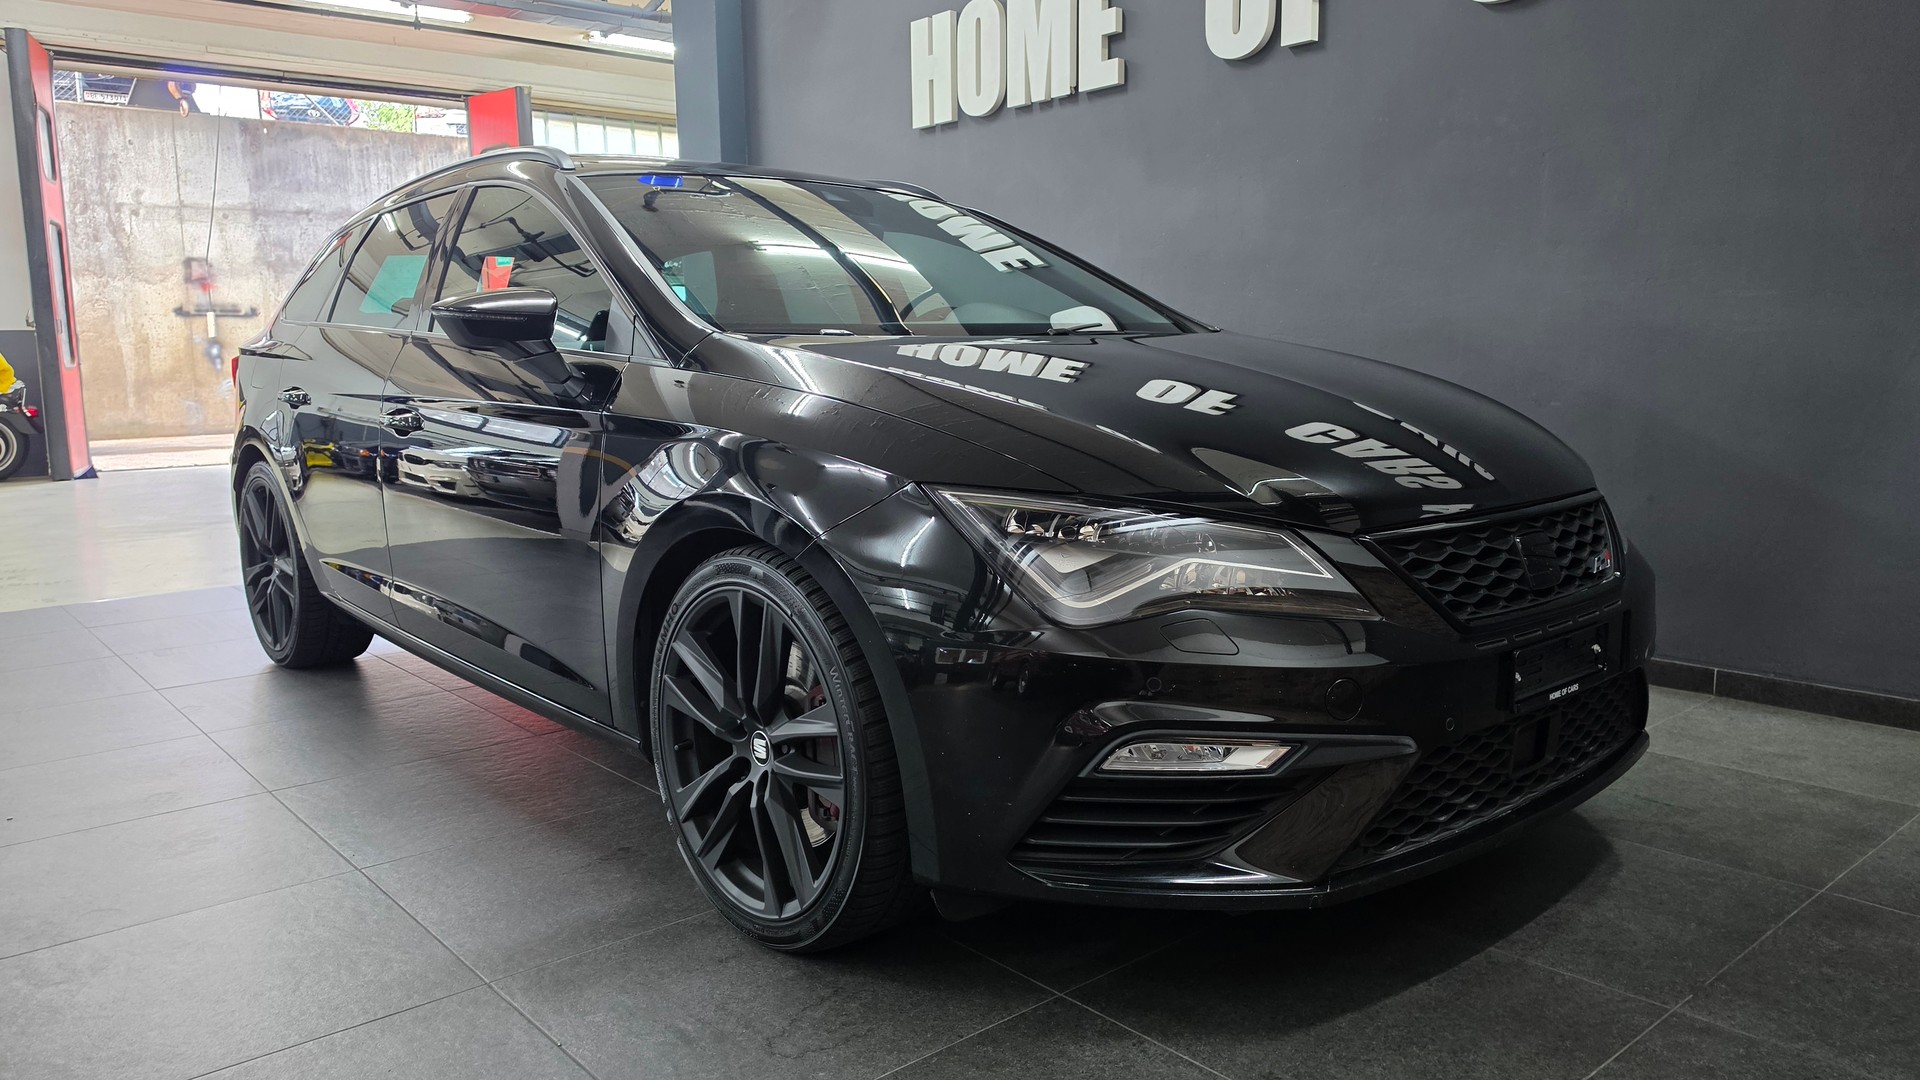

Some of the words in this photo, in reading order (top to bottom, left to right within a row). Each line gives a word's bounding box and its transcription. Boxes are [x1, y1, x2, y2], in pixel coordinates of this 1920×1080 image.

[910, 0, 1125, 129] HOME
[1561, 687, 1568, 696] OF
[1567, 683, 1579, 694] CARS
